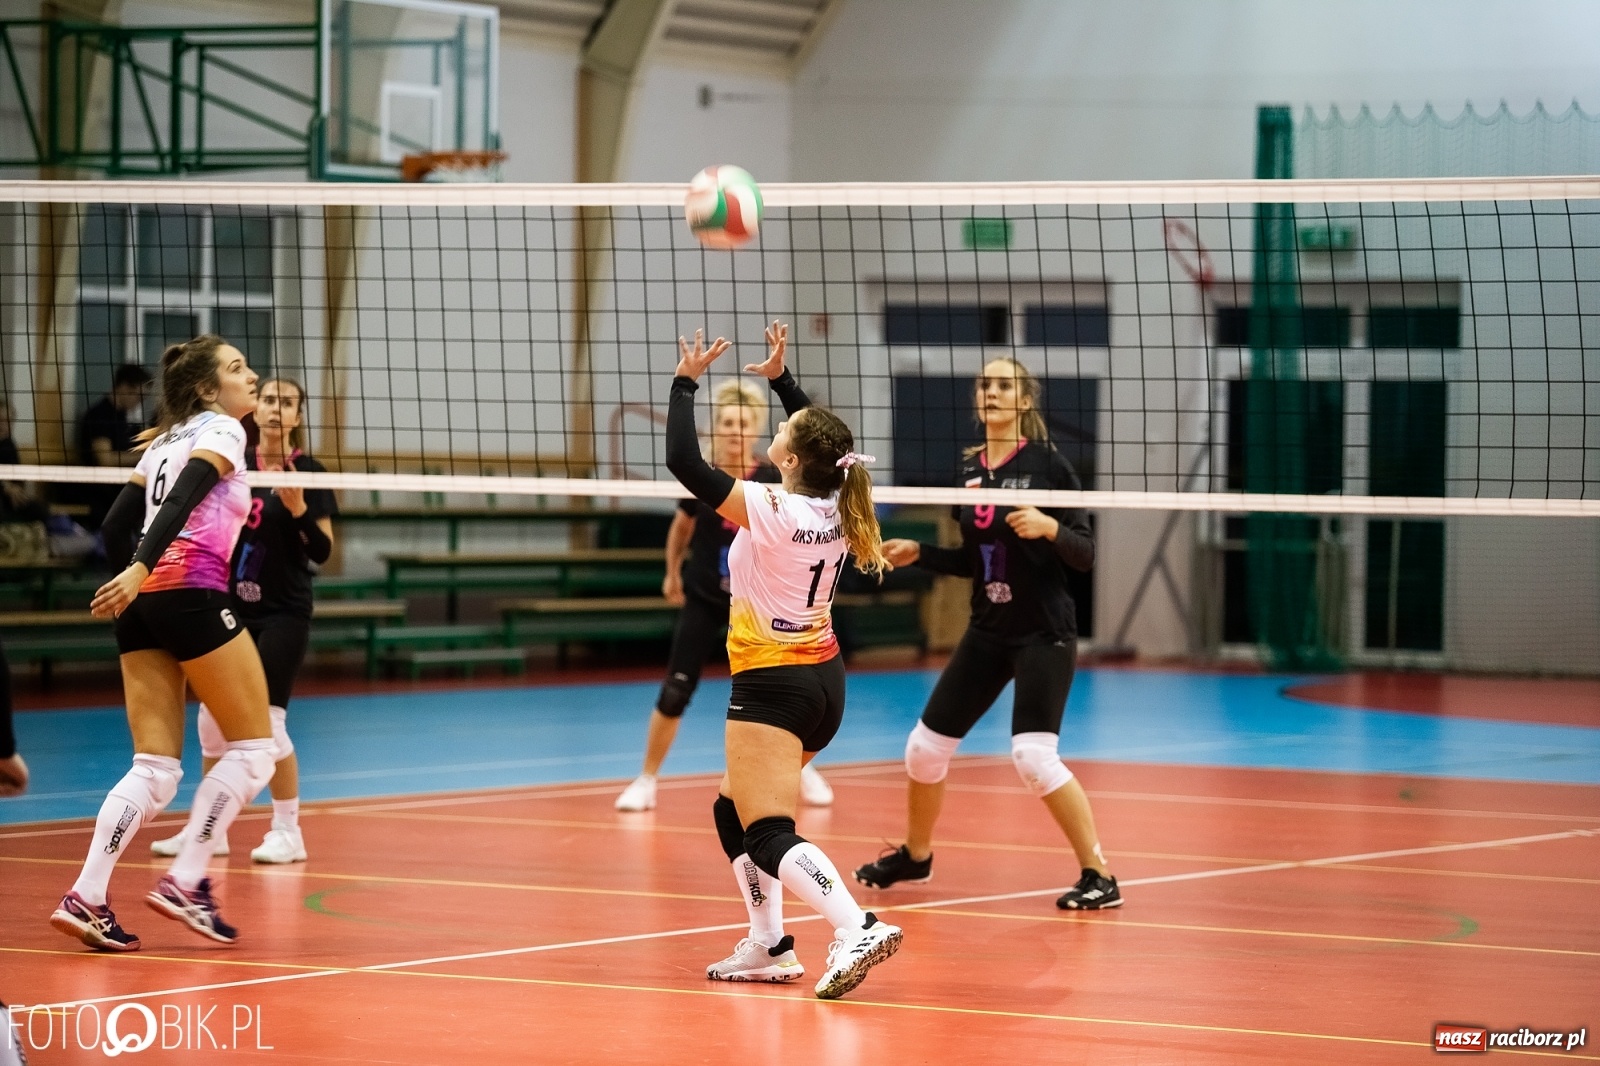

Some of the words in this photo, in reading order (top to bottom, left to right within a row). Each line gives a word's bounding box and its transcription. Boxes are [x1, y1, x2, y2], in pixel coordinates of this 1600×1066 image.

[152, 458, 167, 506] 6
[974, 503, 996, 529] 9
[792, 529, 814, 545] UKS
[806, 552, 844, 608] 11
[220, 608, 237, 630] 6
